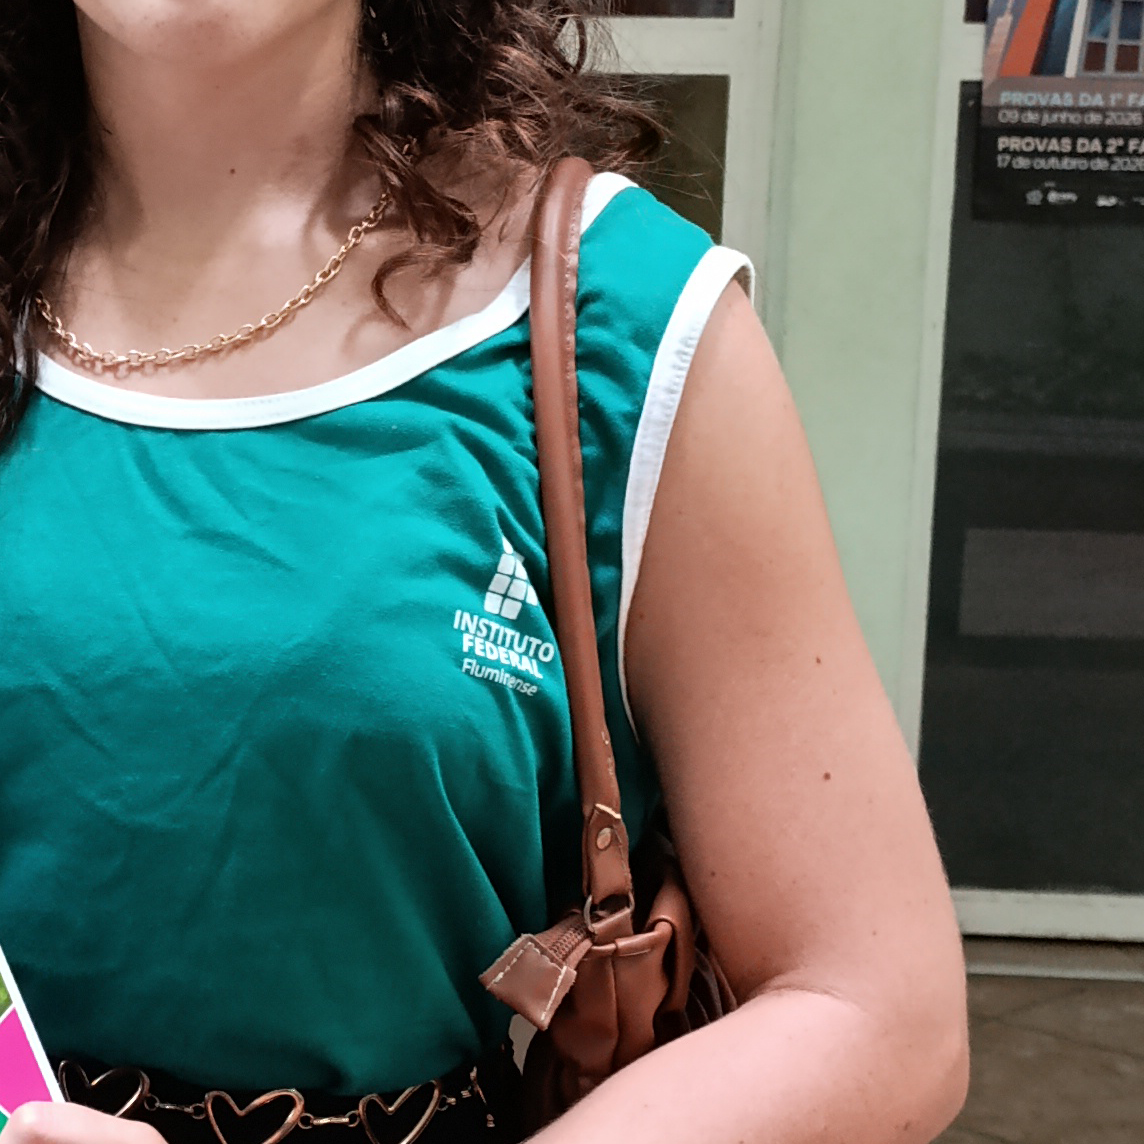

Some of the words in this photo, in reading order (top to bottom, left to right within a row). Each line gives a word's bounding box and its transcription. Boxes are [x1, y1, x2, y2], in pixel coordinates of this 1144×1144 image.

[1000, 90, 1074, 107] PROVAS
[1078, 91, 1104, 107] DA
[1020, 109, 1039, 124] de
[1040, 110, 1082, 127] junho
[1083, 111, 1104, 126] de
[997, 136, 1072, 153] PROVAS
[1076, 136, 1103, 154] DA
[997, 153, 1011, 169] 17
[1011, 156, 1032, 170] de
[1032, 155, 1089, 171] outubro
[1089, 156, 1110, 171] de
[453, 609, 555, 663] INSTITUTO
[462, 633, 543, 679] FEDERAL
